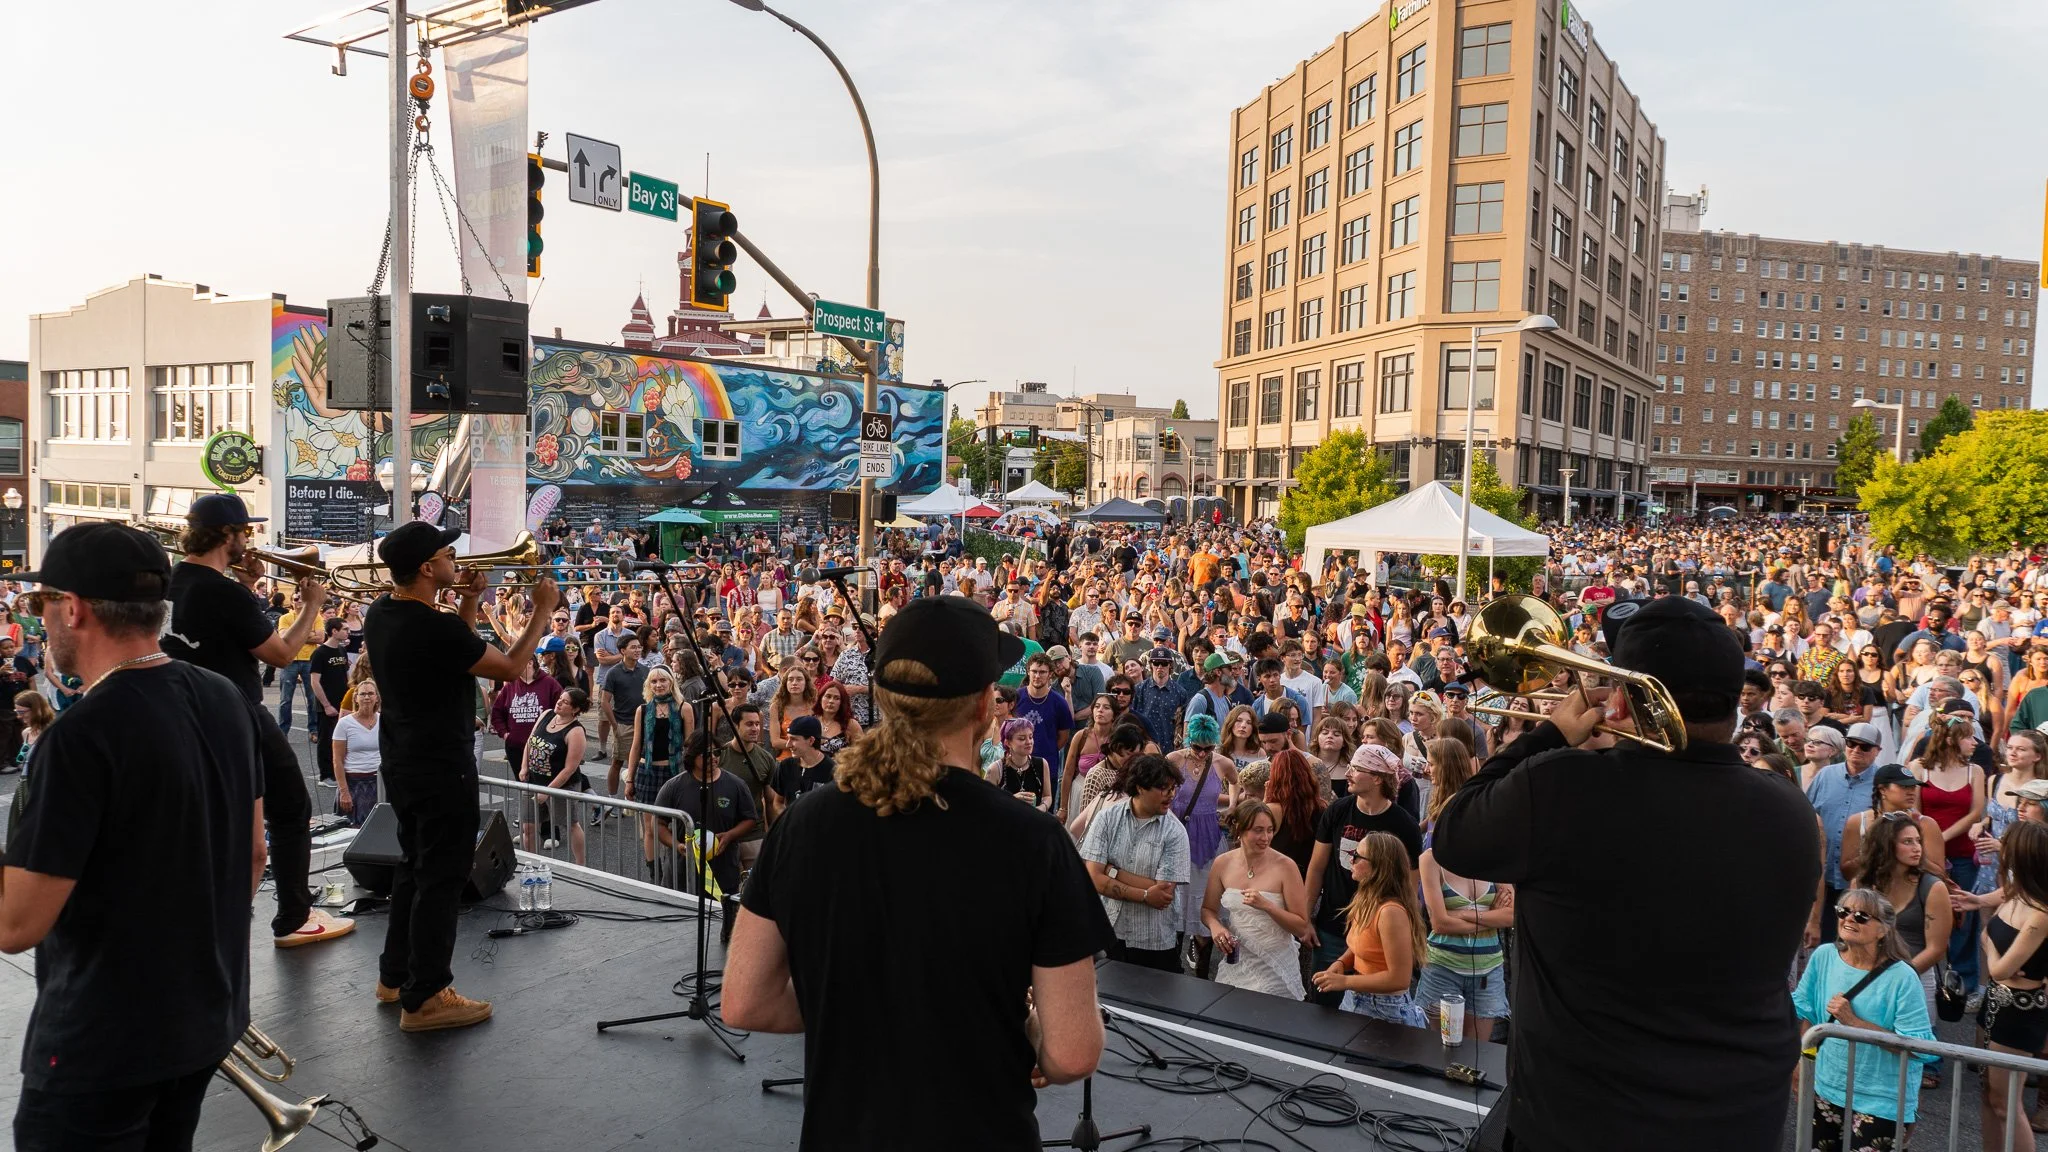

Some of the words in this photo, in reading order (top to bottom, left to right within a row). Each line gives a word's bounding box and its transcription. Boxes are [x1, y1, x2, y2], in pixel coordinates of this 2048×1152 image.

[598, 195, 618, 207] ONLY
[632, 182, 658, 211] Bay
[660, 189, 675, 211] St
[816, 307, 861, 331] Prospect
[864, 316, 874, 333] St
[863, 442, 875, 452] BIKE
[876, 443, 889, 453] LANE
[866, 462, 885, 473] ENDS
[289, 485, 326, 499] Before
[329, 486, 333, 499] I
[335, 486, 363, 499] die...
[509, 706, 544, 714] FANTASTIC
